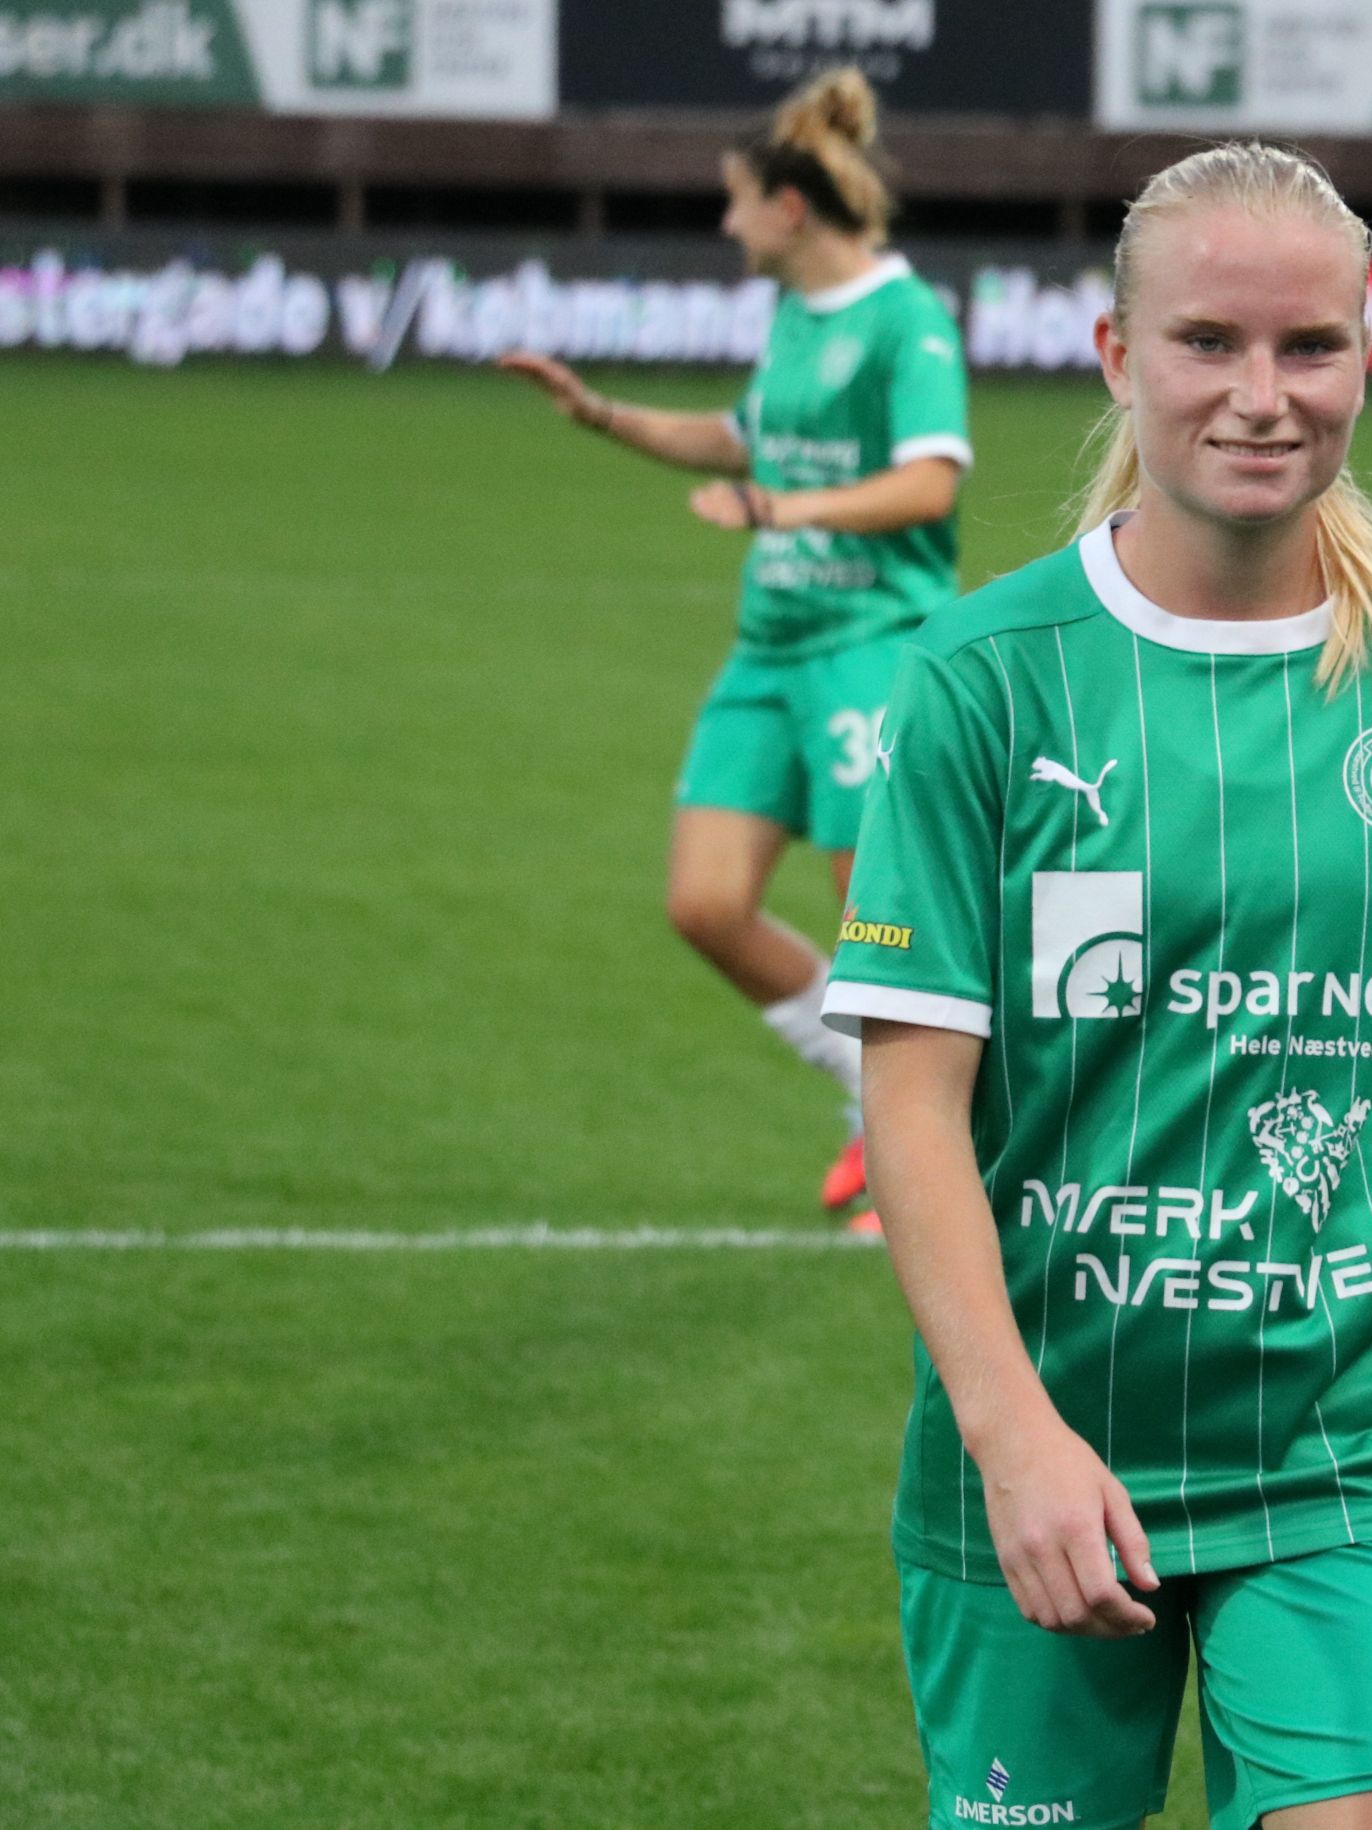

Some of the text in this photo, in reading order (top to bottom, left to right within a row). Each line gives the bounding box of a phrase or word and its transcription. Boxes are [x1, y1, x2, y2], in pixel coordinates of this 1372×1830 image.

[827, 705, 887, 788] 3
[1167, 968, 1316, 1030] spar
[1230, 1034, 1282, 1056] Hele
[1020, 1178, 1259, 1242] MÆRK
[955, 1795, 1075, 1826] EMERSON
